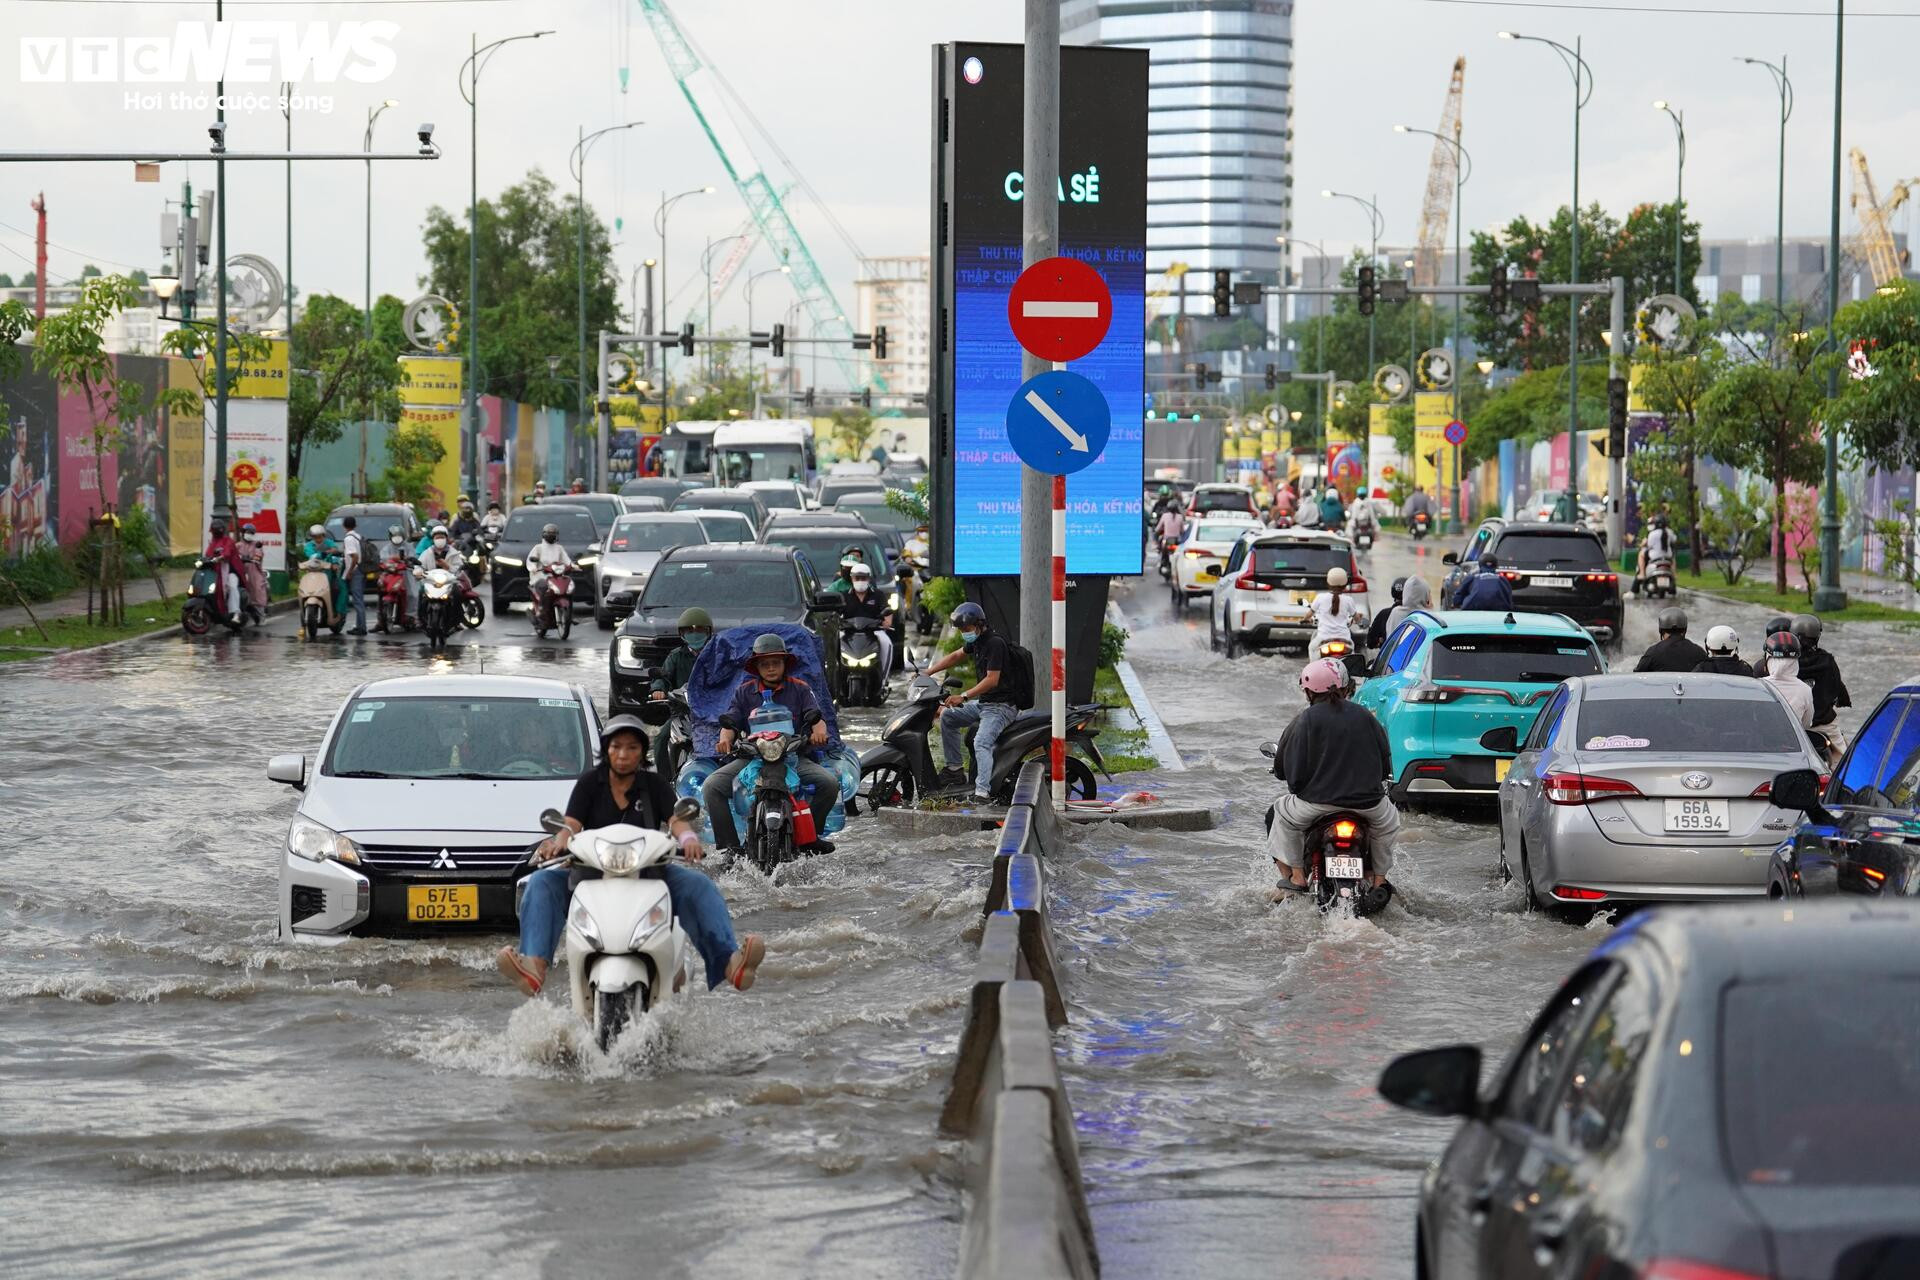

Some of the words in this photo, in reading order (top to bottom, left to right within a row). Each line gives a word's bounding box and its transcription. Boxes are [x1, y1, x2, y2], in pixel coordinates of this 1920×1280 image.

[1070, 165, 1100, 202] SẺ
[979, 247, 999, 260] THU
[1003, 245, 1023, 263] THẬ
[977, 502, 999, 515] THU
[1103, 499, 1123, 515] KẾT
[1682, 801, 1710, 814] 66A
[1673, 815, 1722, 829] 159.94
[428, 888, 458, 902] 67E
[416, 904, 470, 918] 002.33
